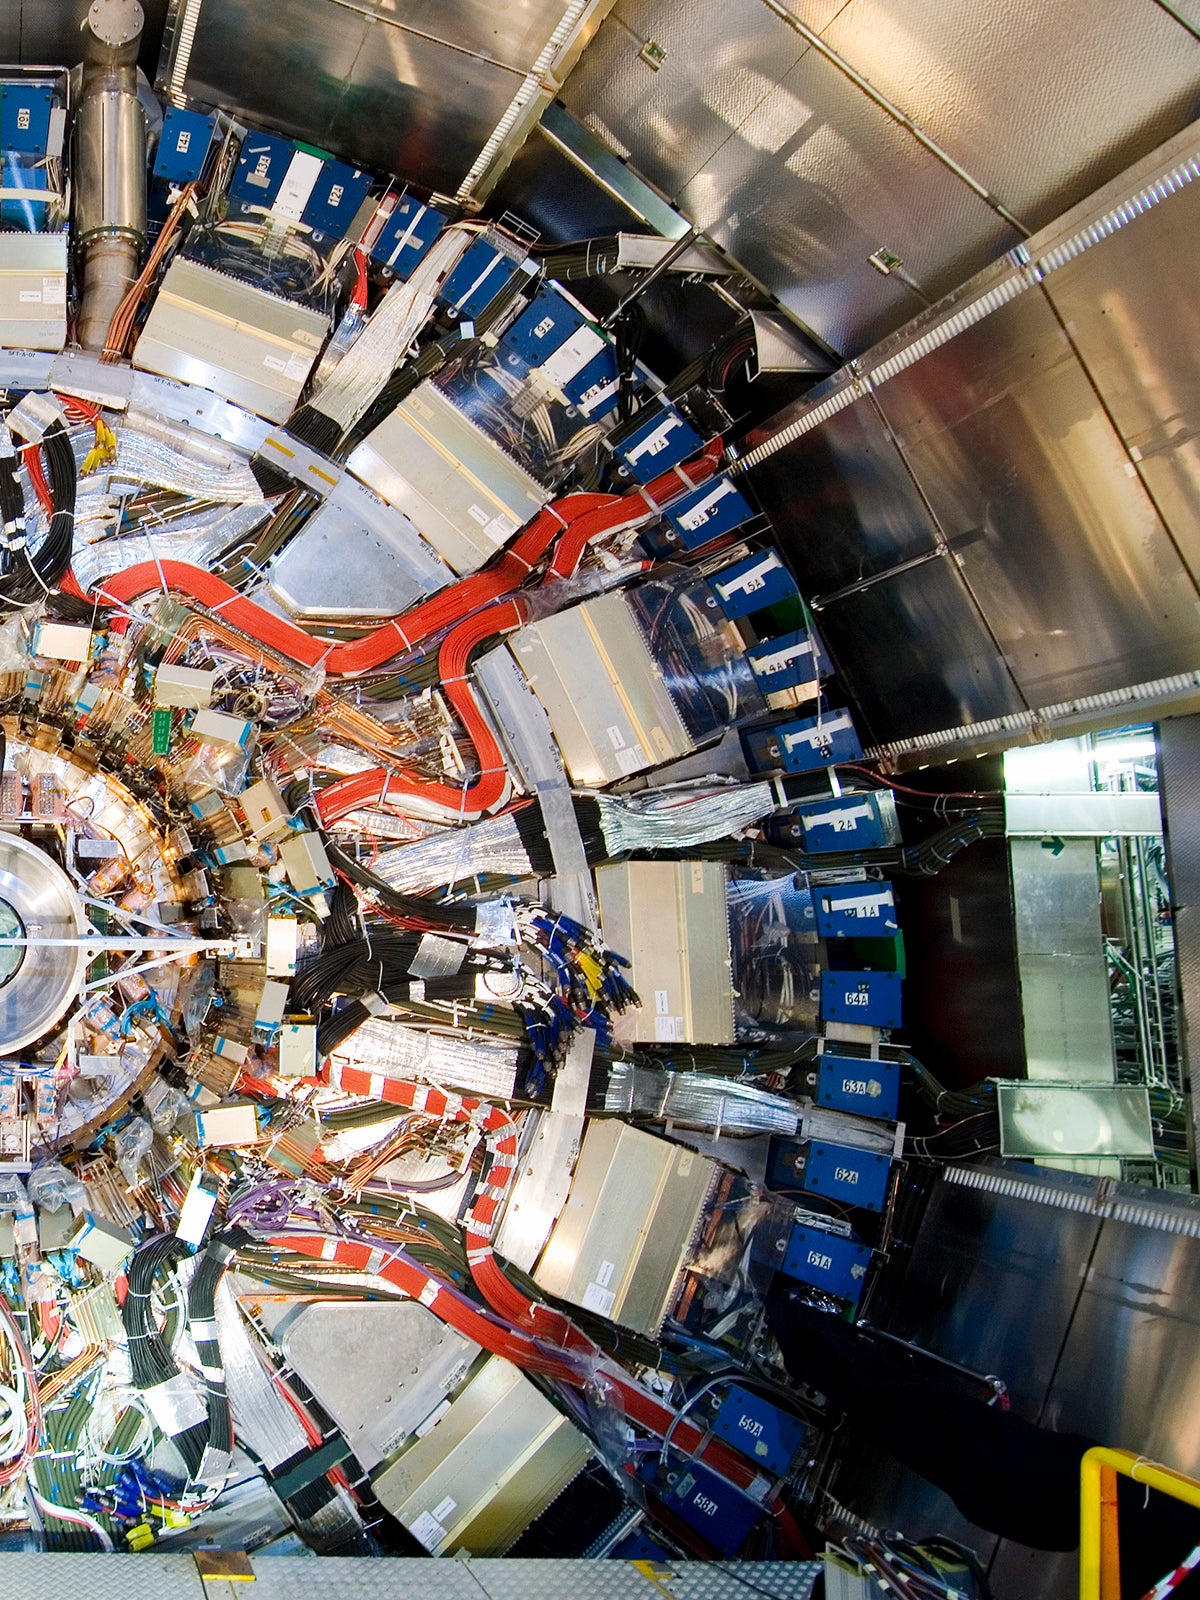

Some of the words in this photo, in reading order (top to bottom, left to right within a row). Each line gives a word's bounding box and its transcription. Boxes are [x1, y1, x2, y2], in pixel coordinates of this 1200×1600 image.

[18, 109, 30, 129] 16A
[177, 132, 191, 153] 14A
[256, 156, 271, 177] 13A
[329, 185, 344, 206] 12A
[536, 319, 553, 337] 9A
[692, 514, 707, 528] 6A
[747, 578, 763, 591] 5A
[511, 664, 528, 692] FT-A-02
[815, 736, 829, 747] 3A
[838, 820, 853, 830] 2A
[863, 906, 876, 917] 1A
[846, 993, 868, 1005] 64A
[843, 1080, 866, 1094] 63A
[836, 1168, 858, 1184] 62A
[808, 1252, 831, 1269] 61A
[740, 1415, 762, 1436] 59A
[695, 1493, 717, 1515] 58A
